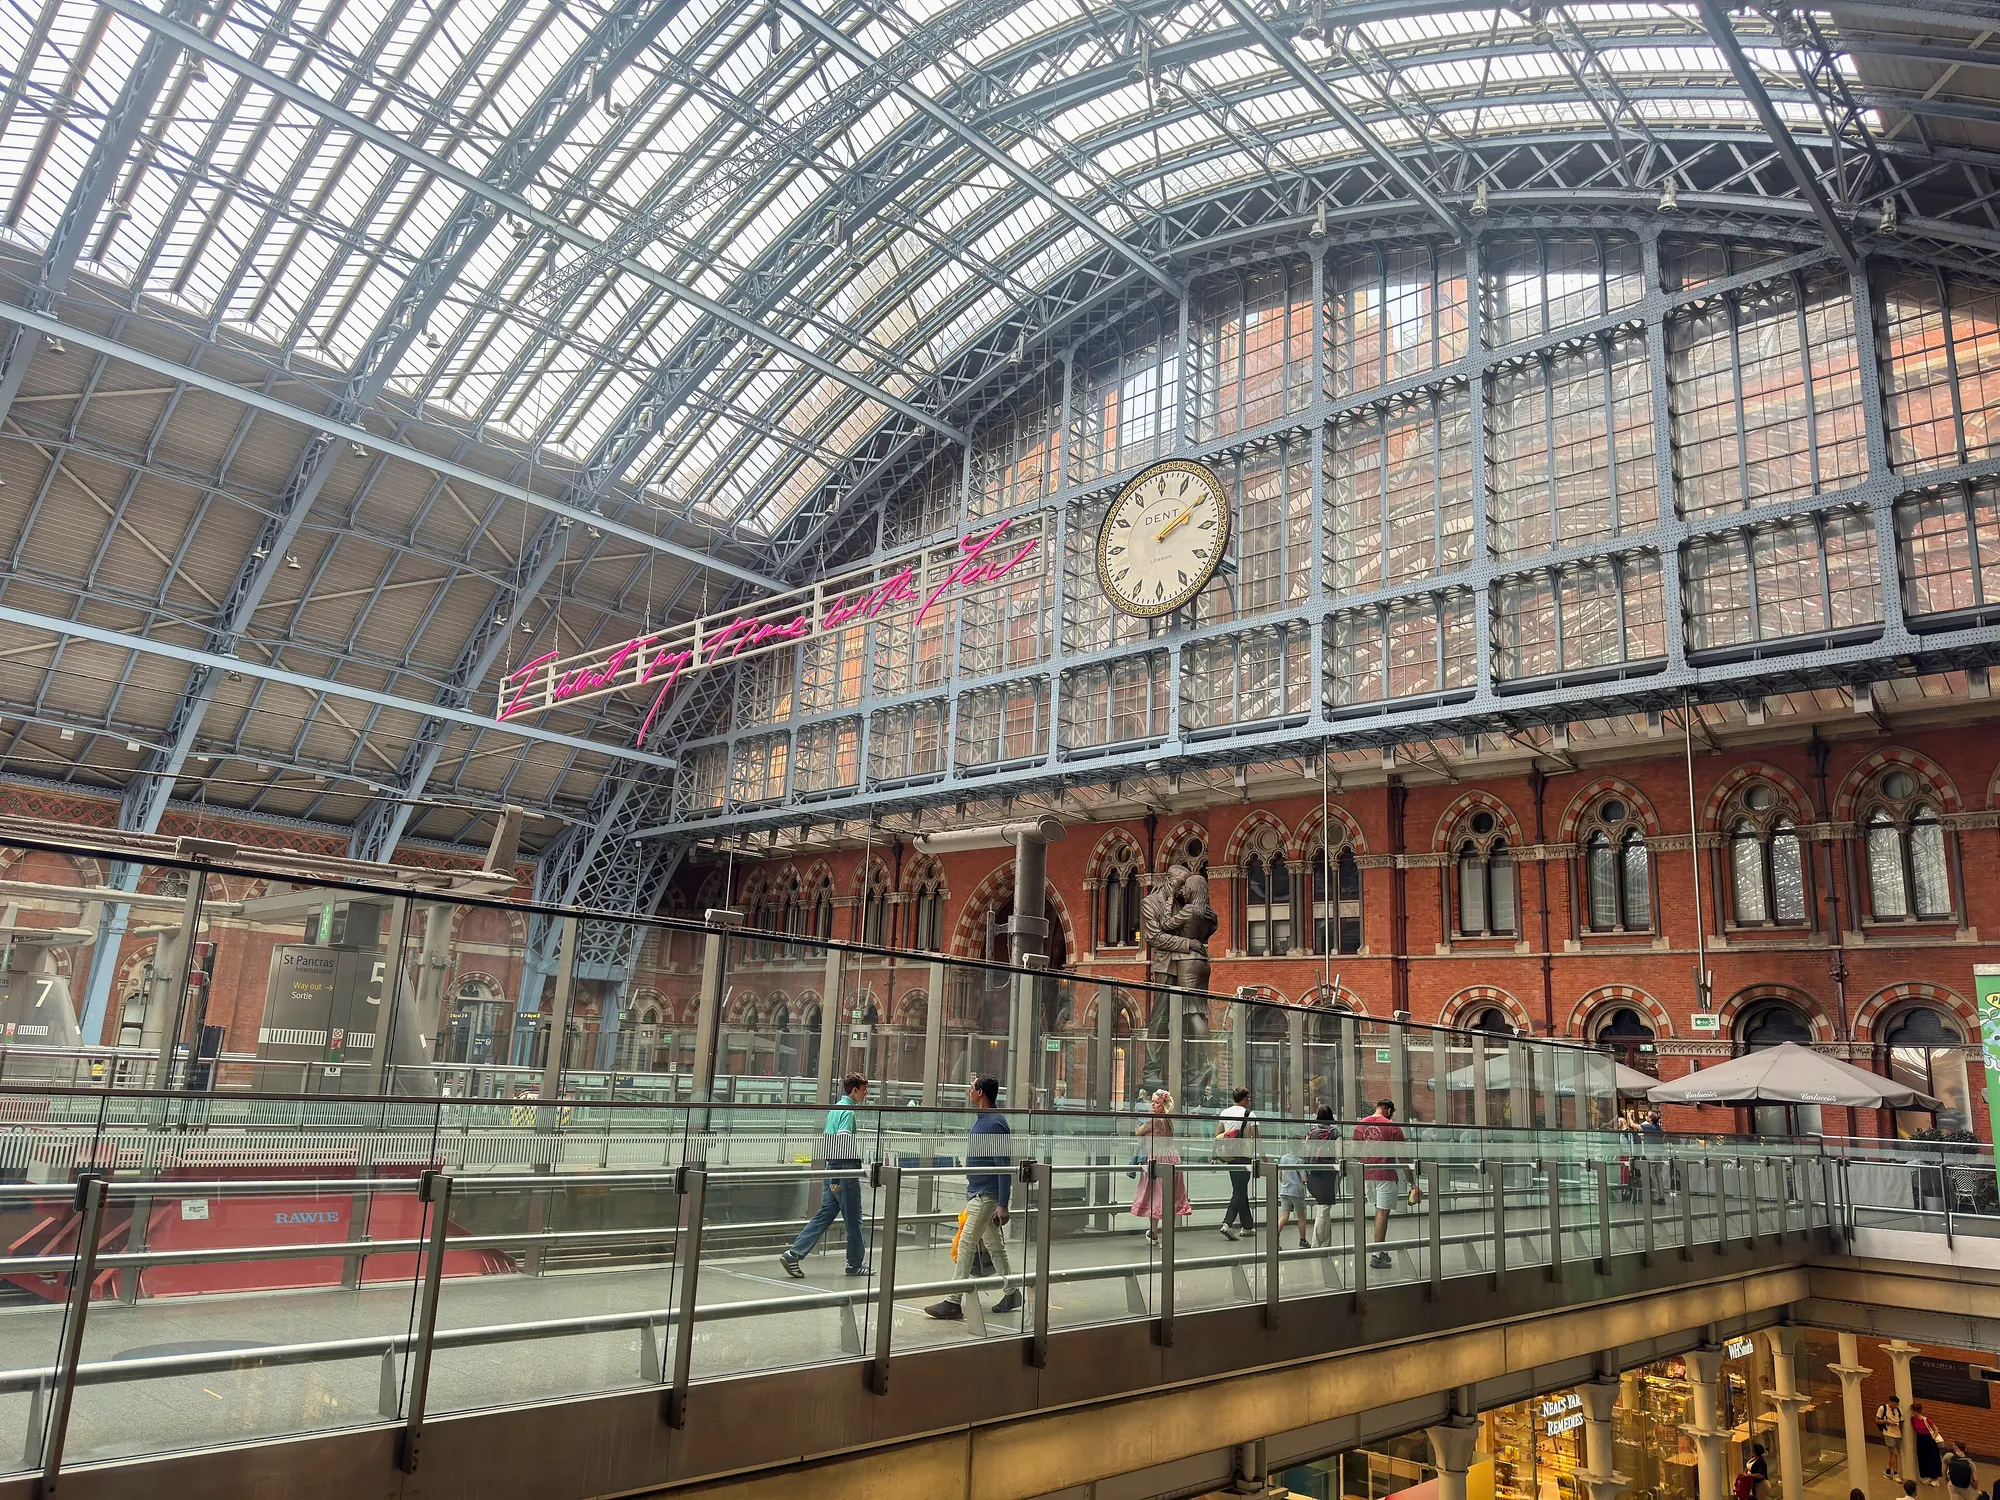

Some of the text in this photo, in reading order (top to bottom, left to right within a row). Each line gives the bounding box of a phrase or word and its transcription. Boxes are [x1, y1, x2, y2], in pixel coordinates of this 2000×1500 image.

[1145, 508, 1179, 526] DENT
[1150, 554, 1172, 564] LONDON
[497, 651, 559, 722] I
[637, 649, 693, 747] my
[701, 615, 806, 664] time
[823, 566, 918, 629] with
[916, 519, 1036, 625] You
[283, 954, 334, 968] St Pancras
[295, 966, 333, 975] International
[293, 981, 322, 991] Way out
[366, 962, 386, 1005] 5
[35, 980, 54, 1008] 7
[291, 991, 313, 1000] Sortie
[1684, 1090, 1718, 1099] Carluccio's
[1800, 1091, 1837, 1102] Carluccio's
[275, 1211, 339, 1224] RAWIE
[1728, 1338, 1754, 1360] WHSmith
[1541, 1394, 1583, 1418] NEAL'S YAR
[1546, 1412, 1584, 1437] REMEDIES
